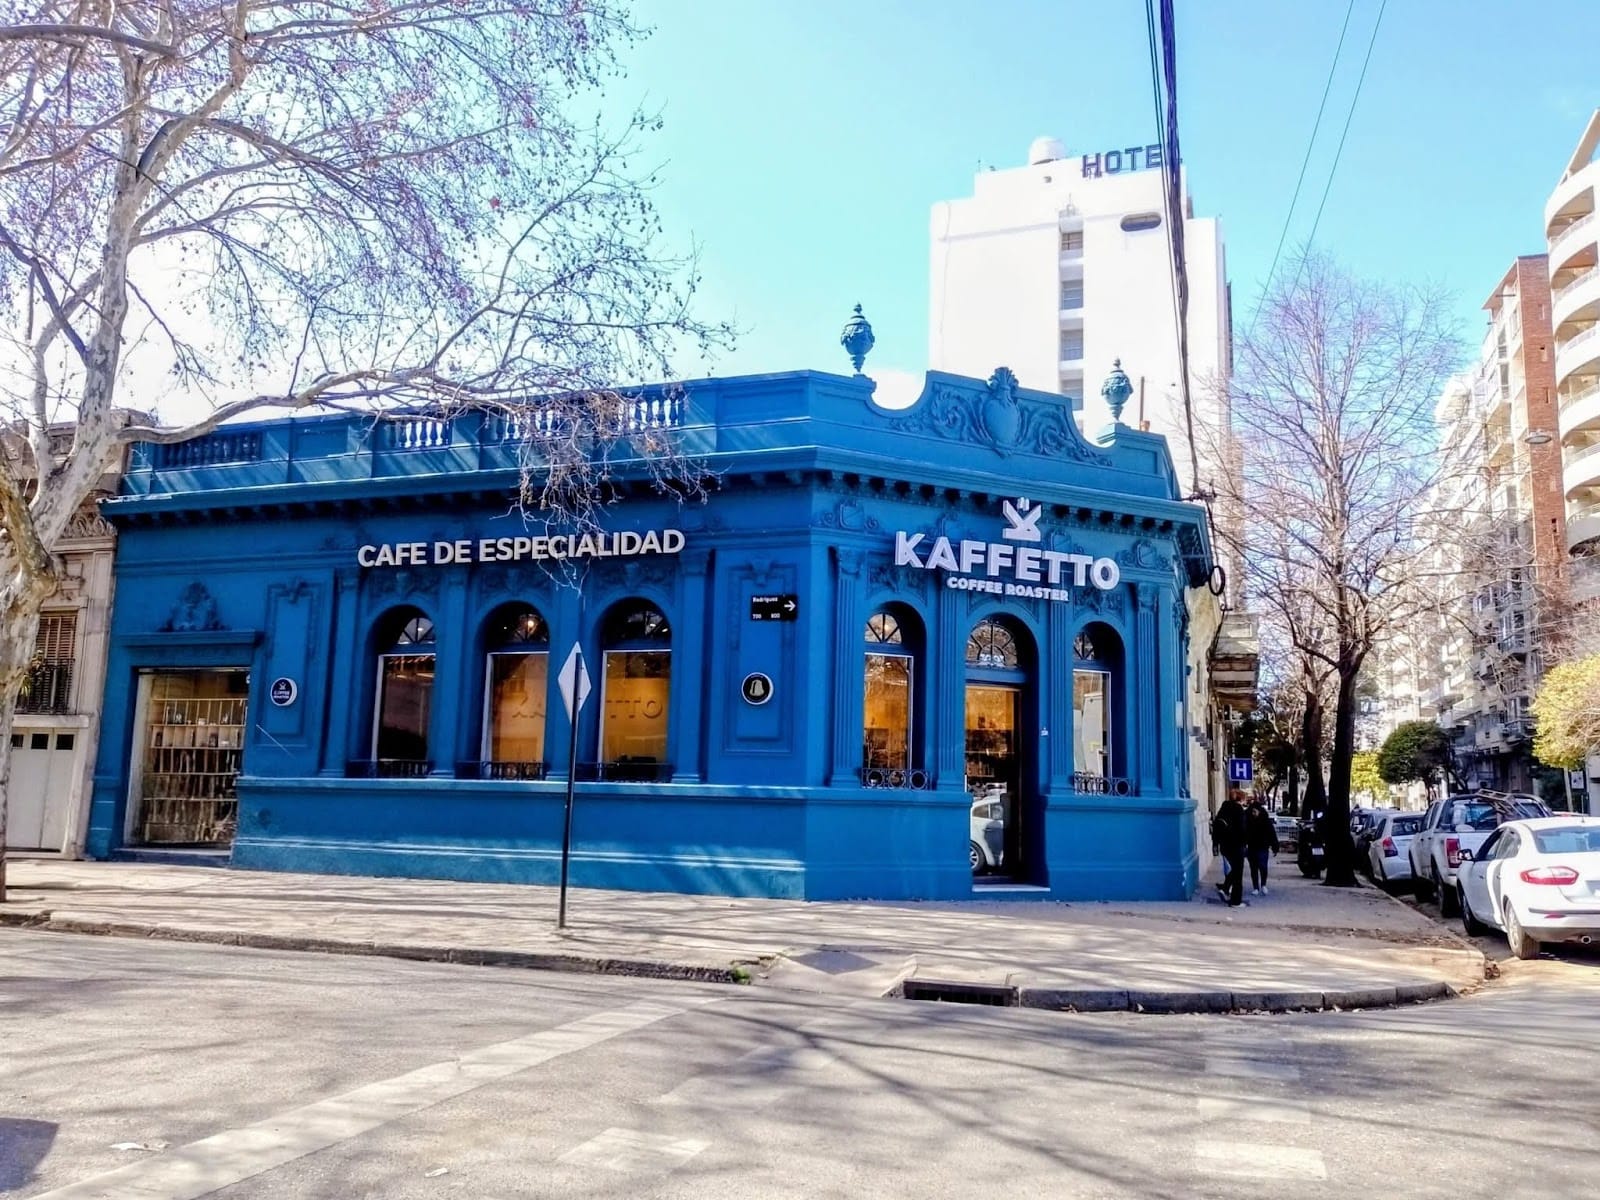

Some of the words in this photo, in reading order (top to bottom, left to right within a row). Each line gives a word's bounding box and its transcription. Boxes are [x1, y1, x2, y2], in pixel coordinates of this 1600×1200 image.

[1082, 144, 1182, 178] HOTE
[357, 542, 427, 567] CAFE
[434, 539, 472, 564] DE
[478, 529, 686, 562] ESPECIALIDAD
[895, 531, 1121, 590] KAFFETTO
[947, 577, 1003, 594] COFFEE
[1005, 583, 1070, 601] ROASTER
[1235, 762, 1247, 779] H
